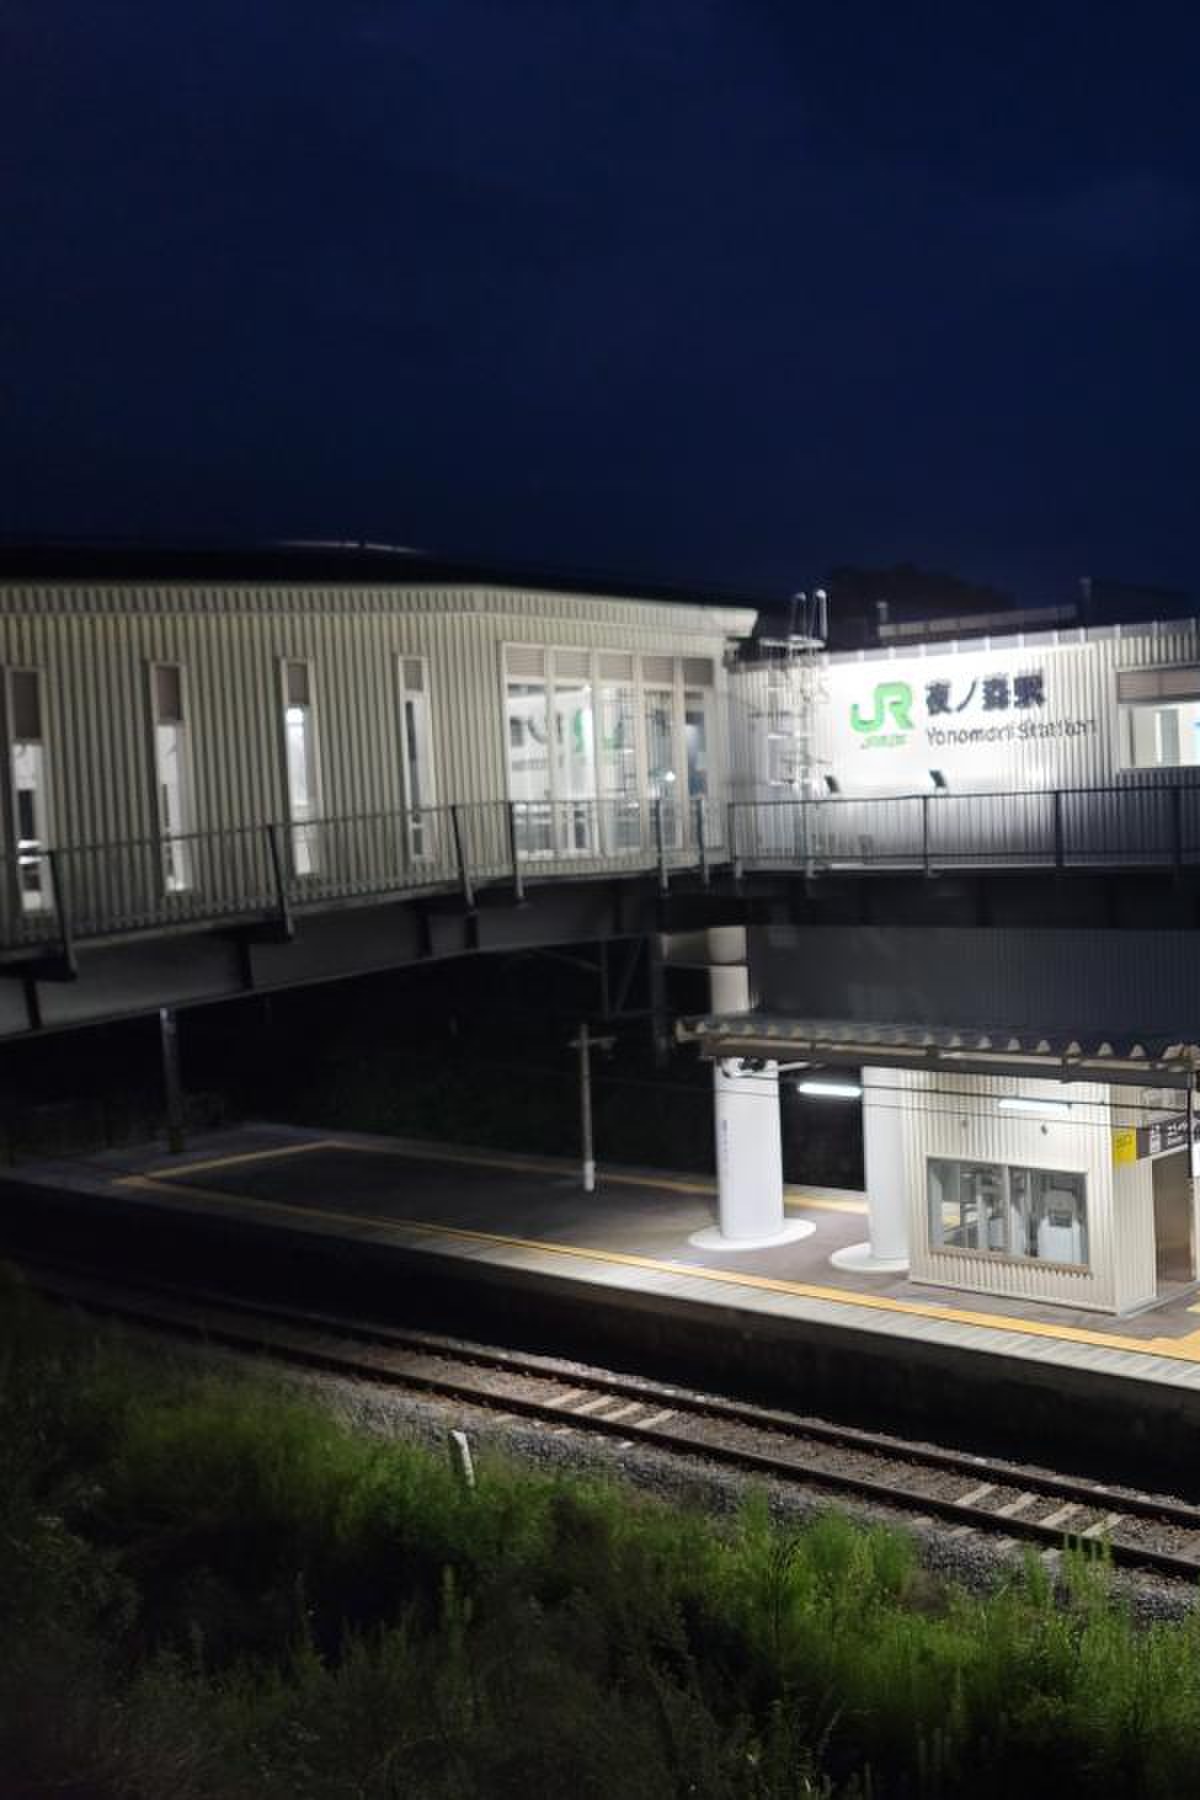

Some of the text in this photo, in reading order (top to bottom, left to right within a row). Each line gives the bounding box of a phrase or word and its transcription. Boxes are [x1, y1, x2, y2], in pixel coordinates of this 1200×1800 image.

[851, 681, 915, 733] JR
[926, 724, 1011, 747] Yonomori
[1019, 719, 1098, 741] Station
